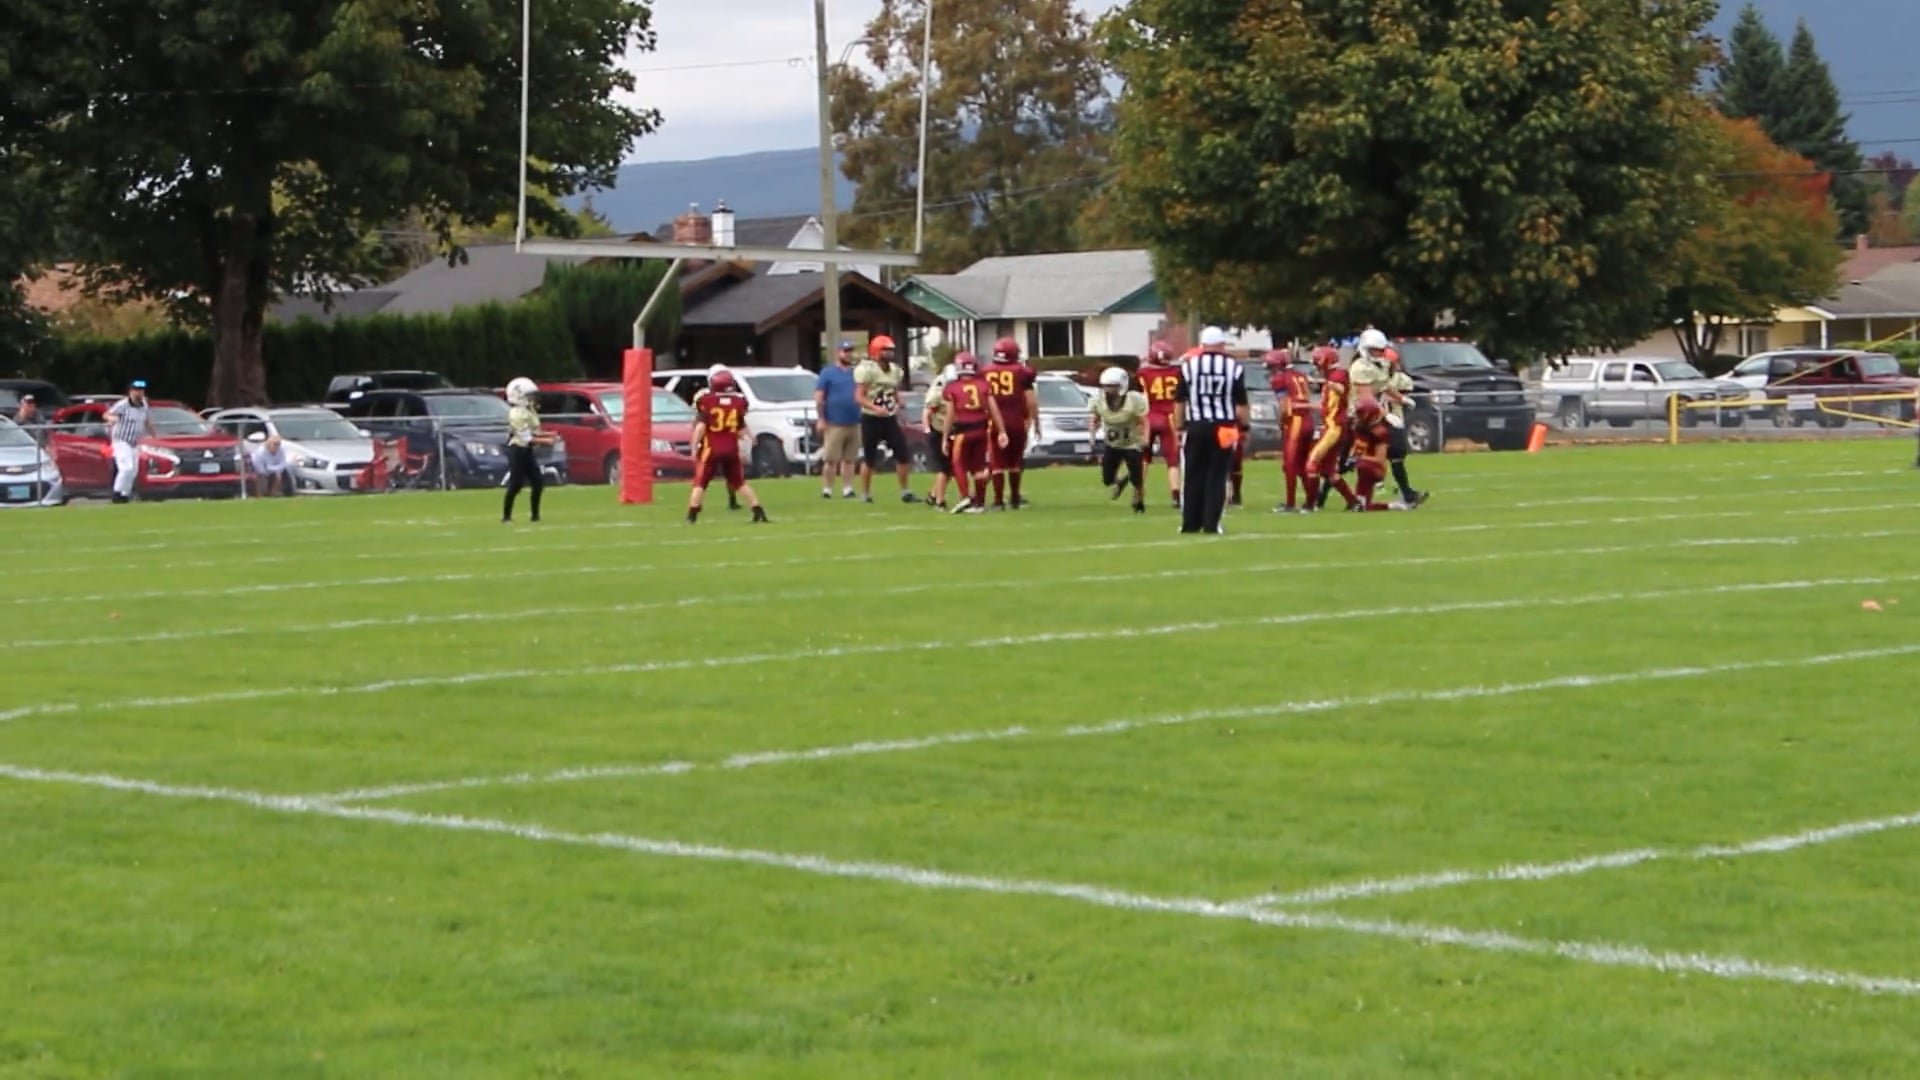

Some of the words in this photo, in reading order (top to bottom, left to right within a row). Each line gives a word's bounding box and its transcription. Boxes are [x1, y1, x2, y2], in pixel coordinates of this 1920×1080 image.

[963, 384, 980, 410] 3
[1150, 376, 1179, 400] 42
[1199, 375, 1225, 395] 117
[710, 407, 739, 433] 34
